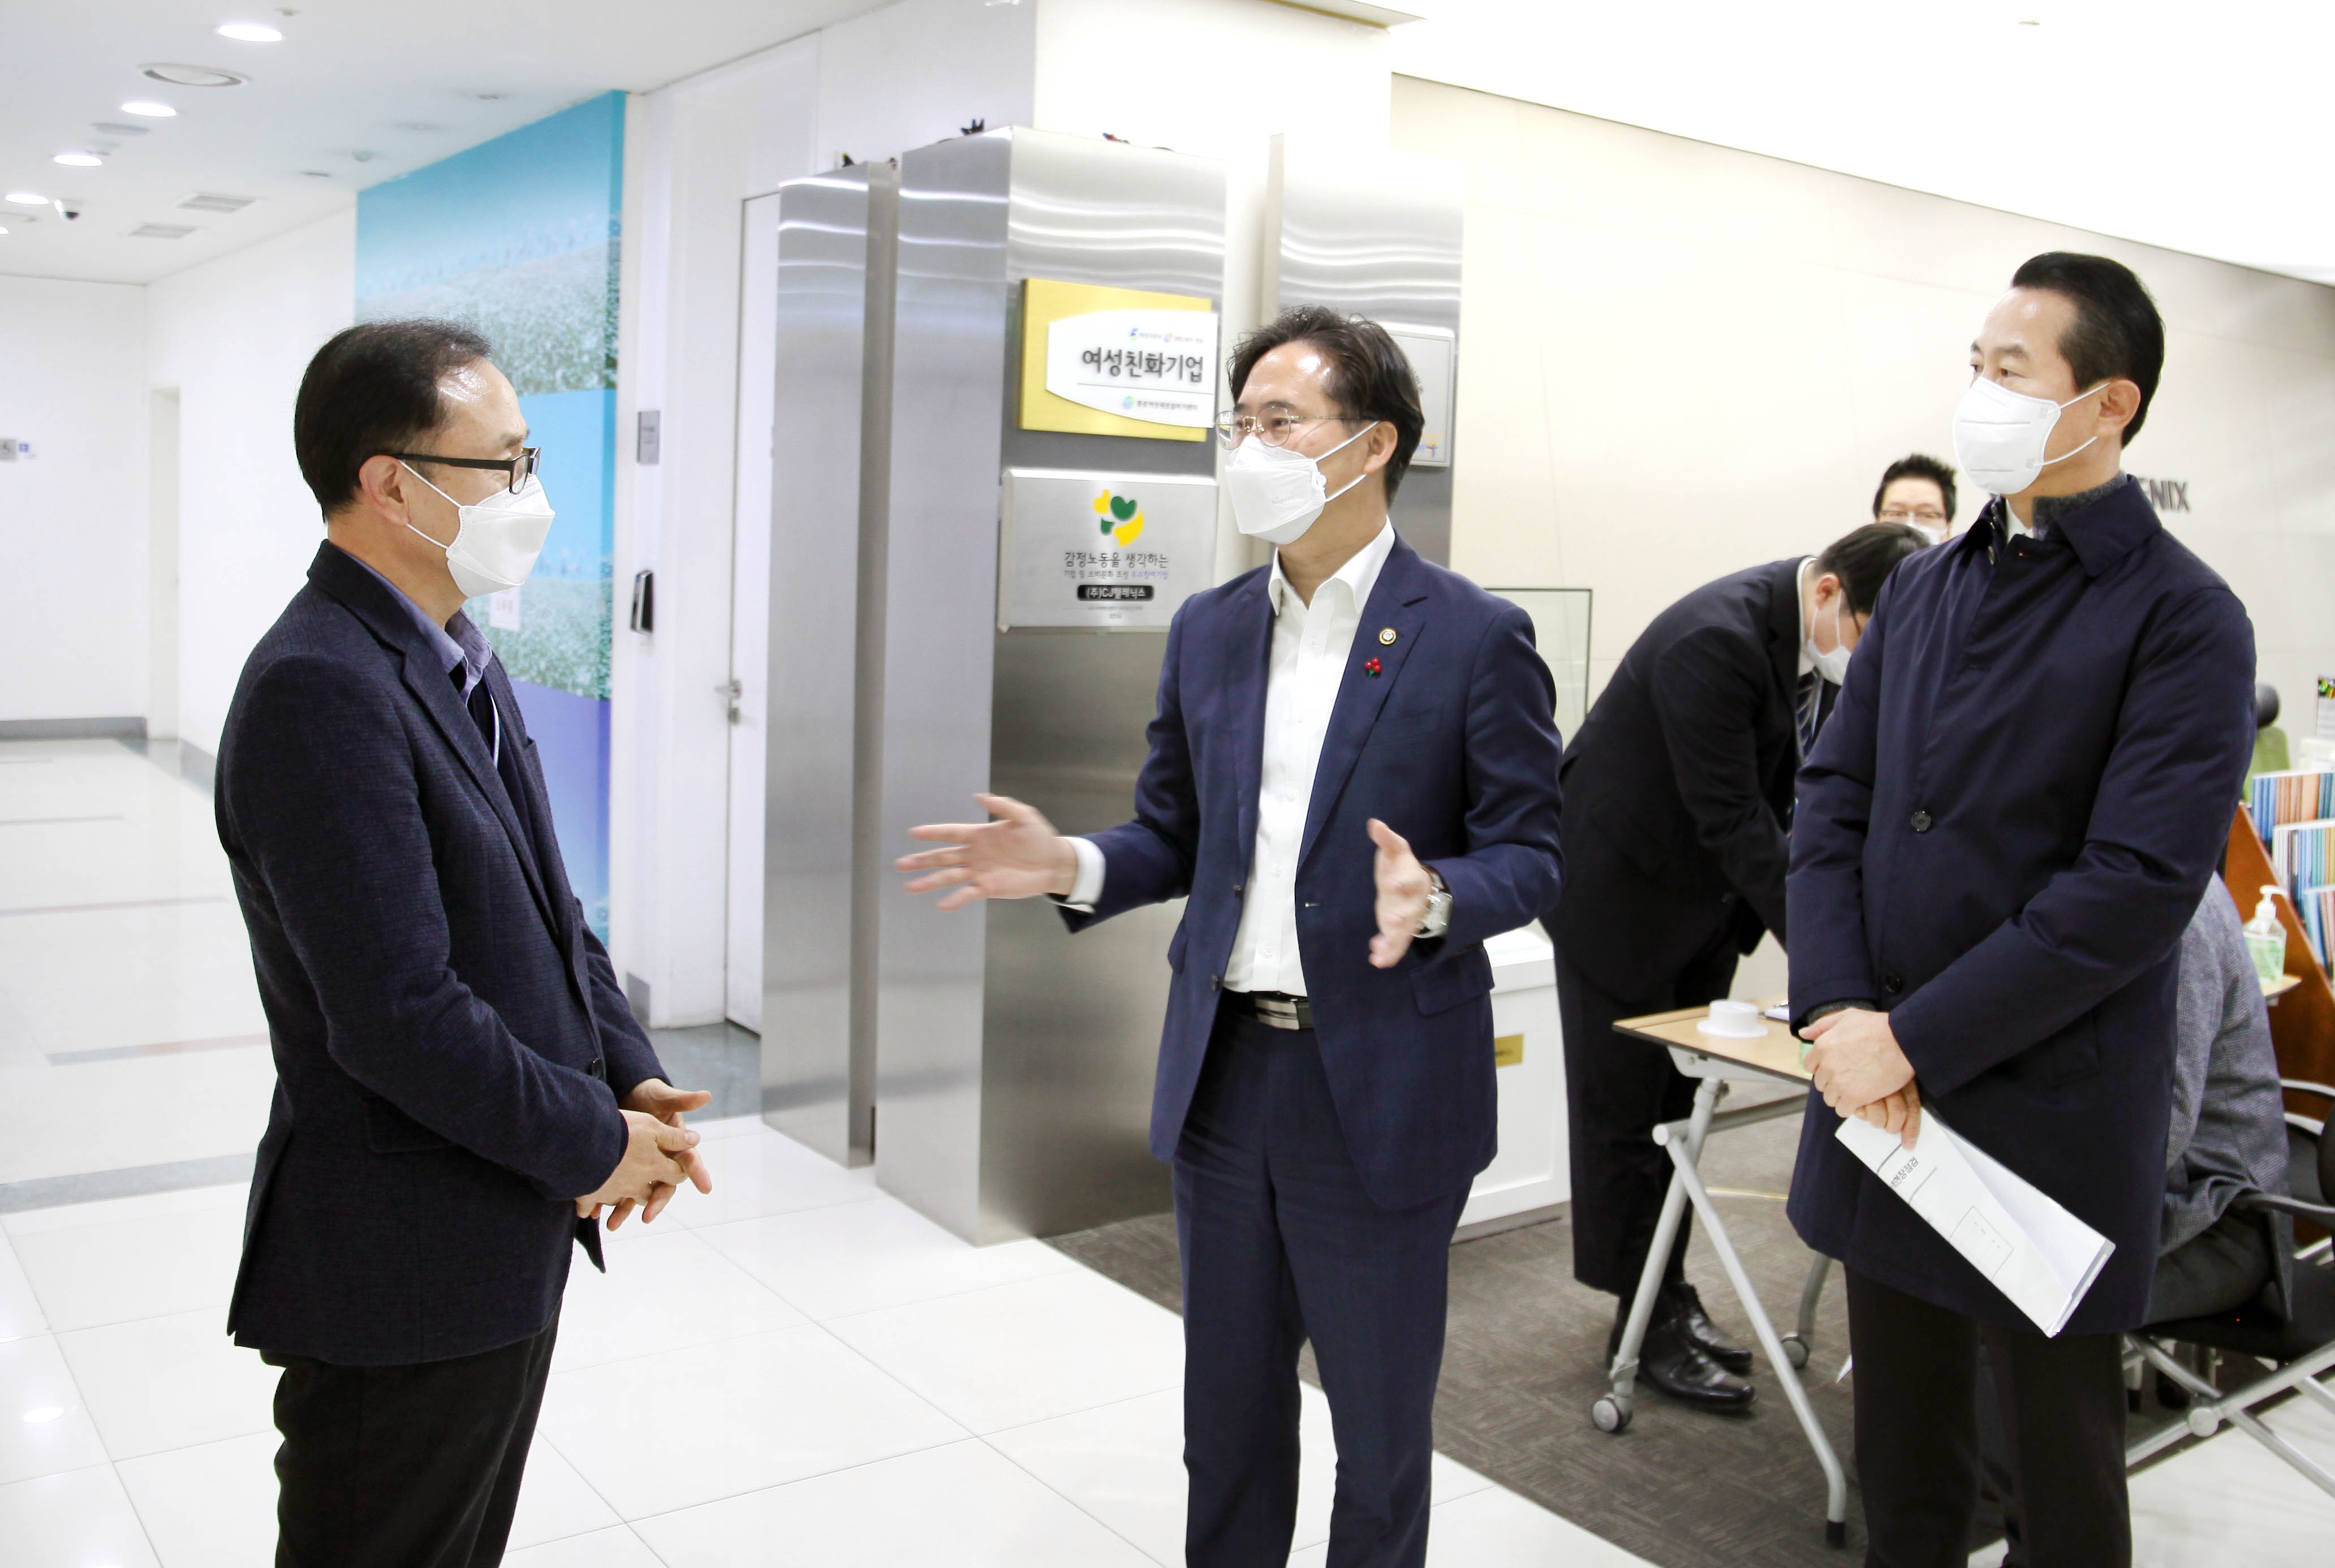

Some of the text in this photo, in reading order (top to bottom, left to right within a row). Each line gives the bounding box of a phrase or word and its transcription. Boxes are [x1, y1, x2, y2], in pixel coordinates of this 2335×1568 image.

[1082, 347, 1204, 384] 여성친화기업
[2138, 478, 2191, 512] NIX
[1065, 552, 1169, 569] 감정노동을 생각하는
[1087, 587, 1146, 600] (주)CJ텔레닉스
